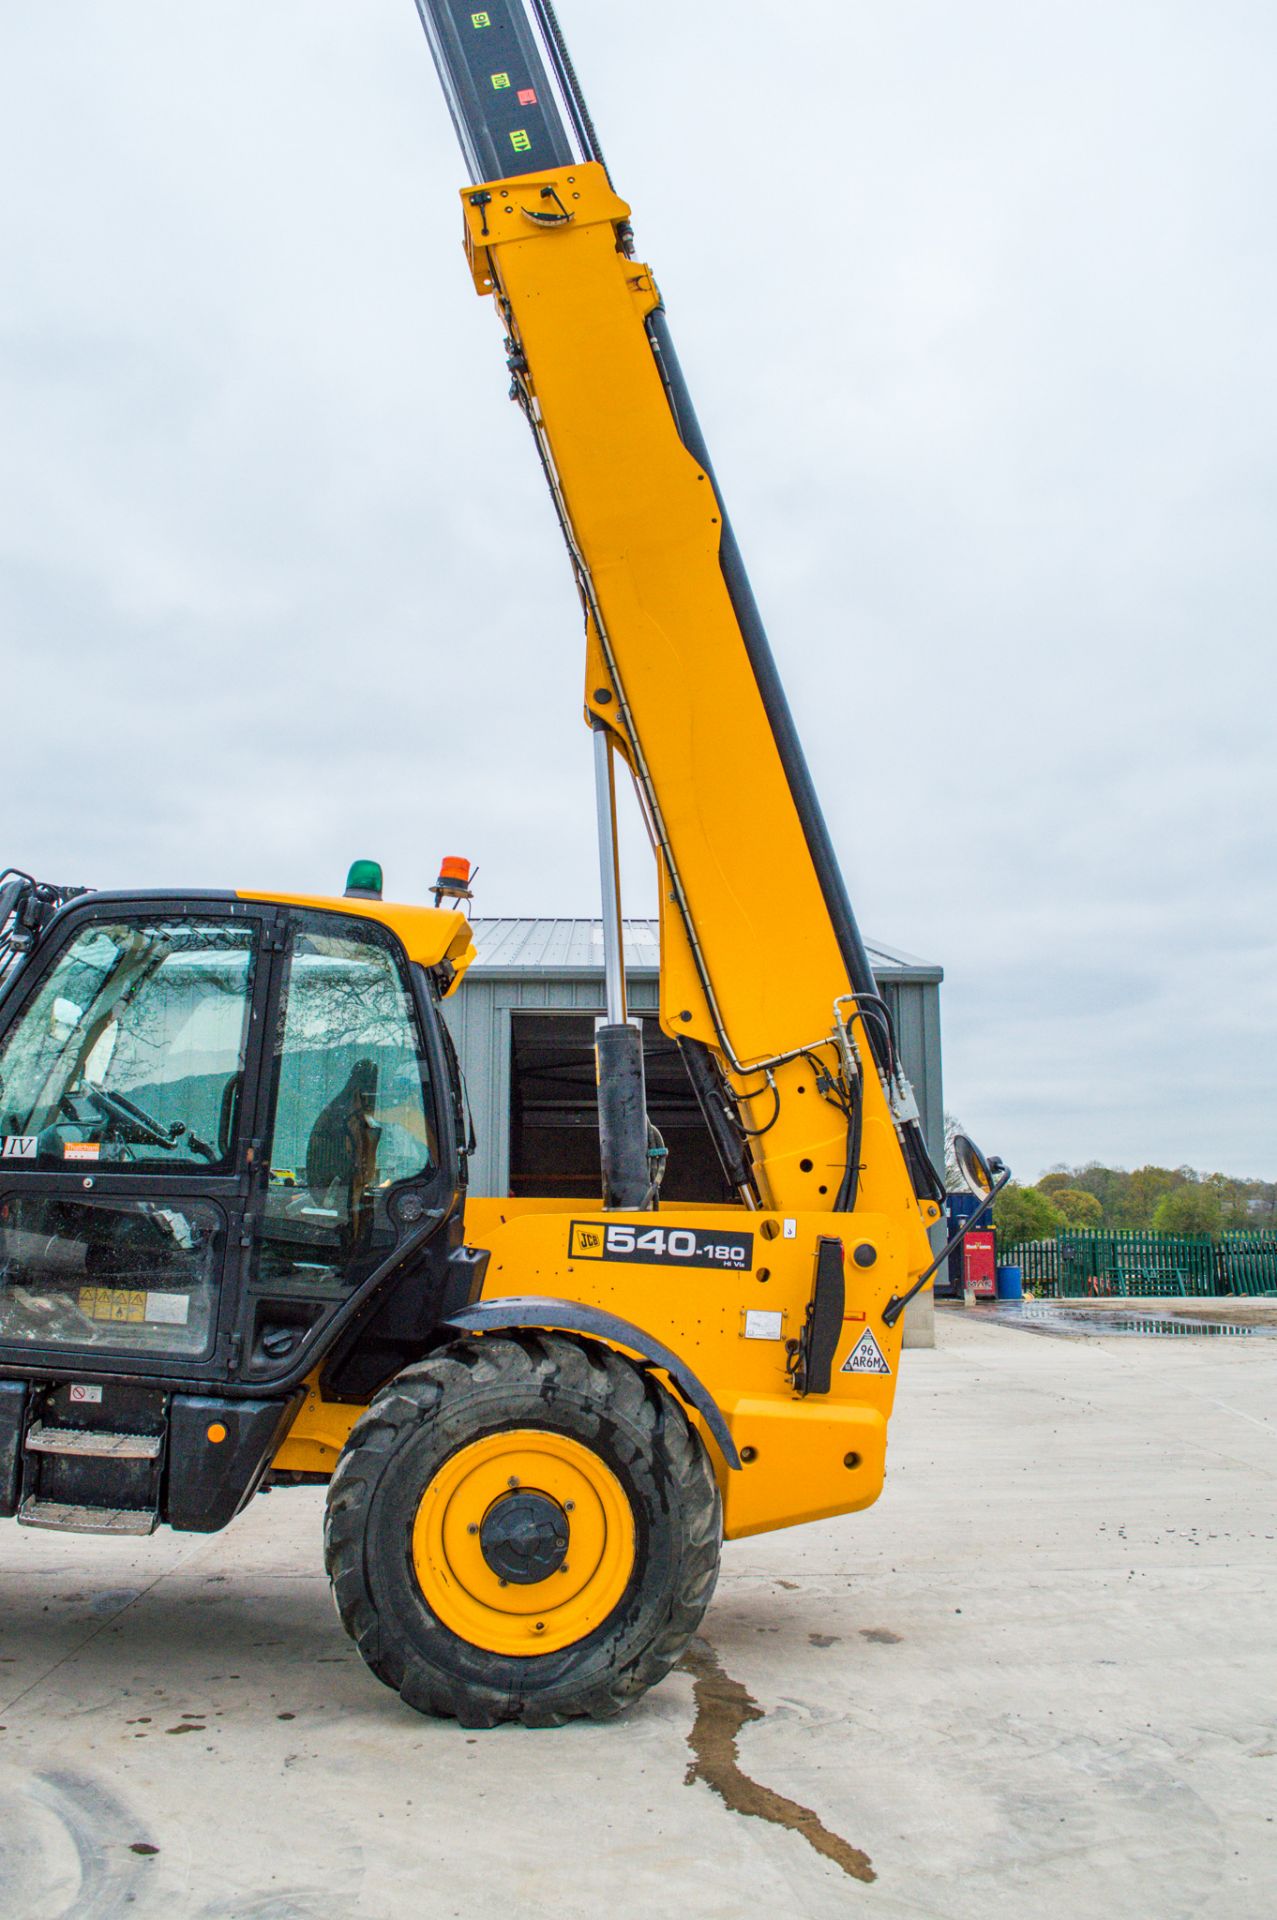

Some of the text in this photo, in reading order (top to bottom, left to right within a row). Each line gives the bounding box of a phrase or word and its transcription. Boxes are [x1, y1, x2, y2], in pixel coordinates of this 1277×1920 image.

[493, 74, 507, 85] 10
[513, 132, 526, 144] 11
[8, 1138, 34, 1155] IV
[580, 1232, 599, 1248] JCB
[606, 1225, 745, 1261] 540-180
[860, 1344, 874, 1356] 96
[852, 1356, 881, 1368] AR6M
